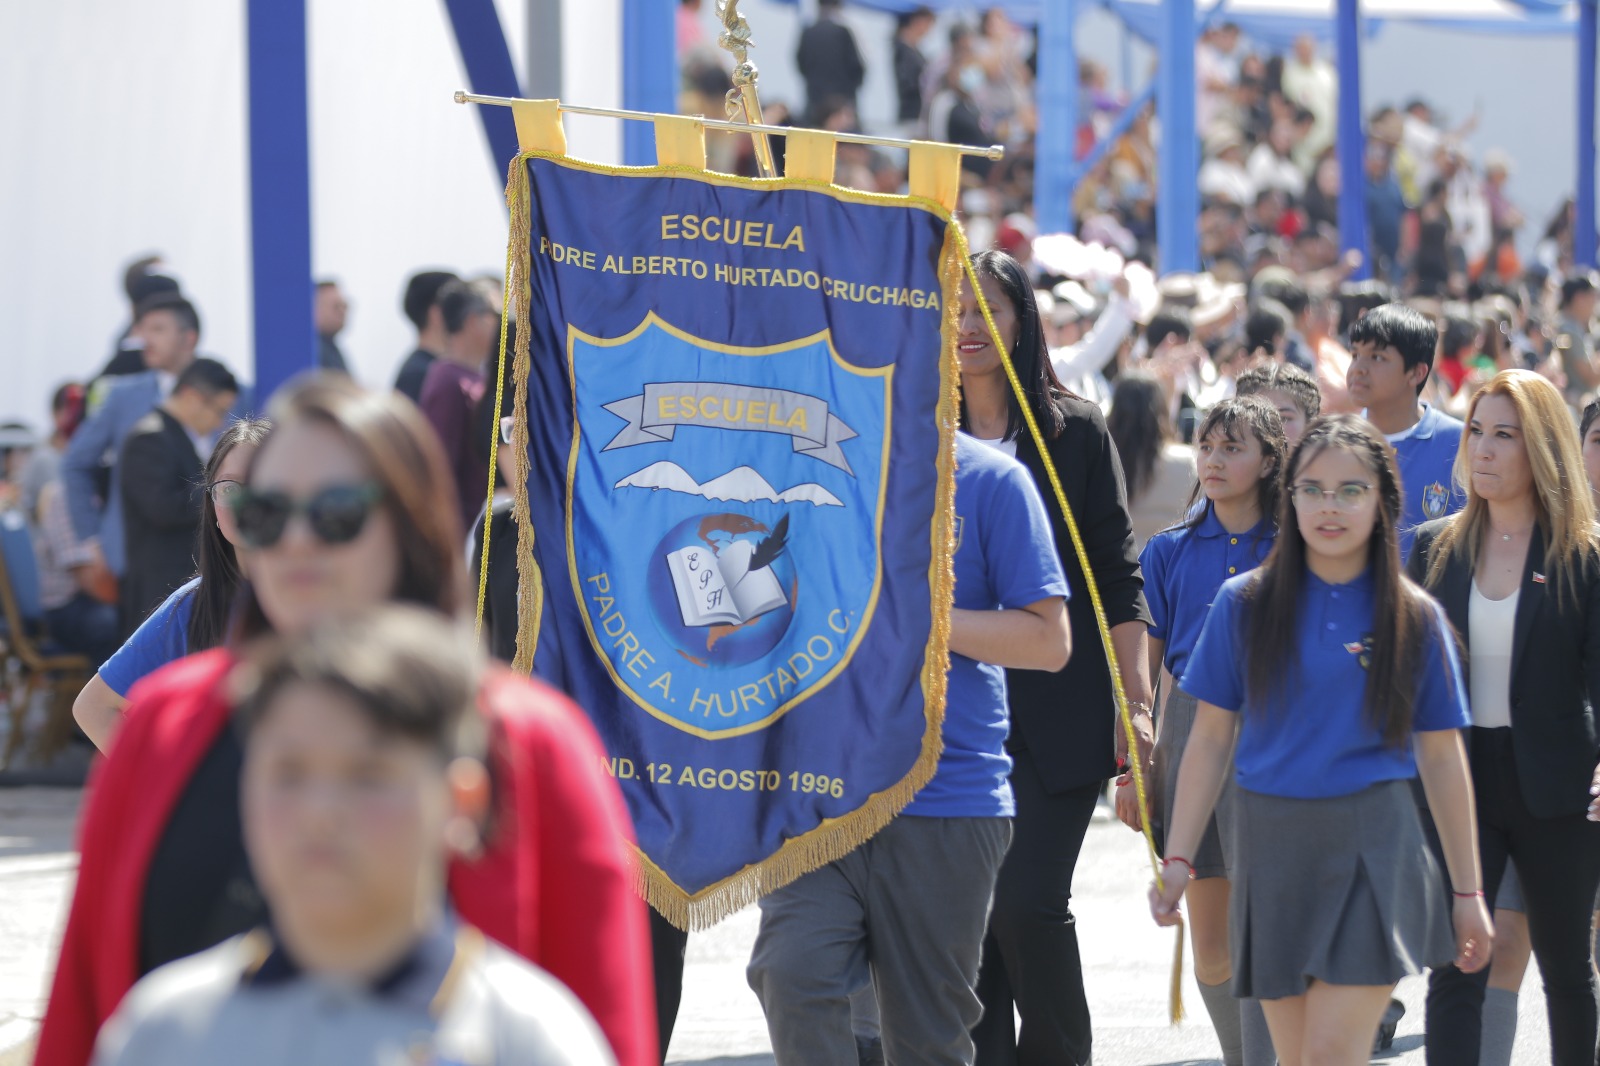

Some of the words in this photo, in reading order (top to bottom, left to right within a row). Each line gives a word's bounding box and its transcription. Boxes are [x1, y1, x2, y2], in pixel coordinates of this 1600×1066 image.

[661, 213, 806, 252] ESCUELA
[602, 254, 708, 280] ALBERTO
[714, 264, 820, 291] HURTADO
[822, 276, 940, 311] CRUCHAGA
[658, 396, 808, 432] ESCUELA
[687, 552, 699, 571] E
[699, 569, 712, 589] P
[587, 572, 656, 678] PADRE
[648, 671, 676, 703] A.
[688, 635, 834, 718] HURTADO
[646, 762, 672, 785] 12
[677, 766, 781, 792] AGOSTO
[788, 773, 845, 799] 1996
